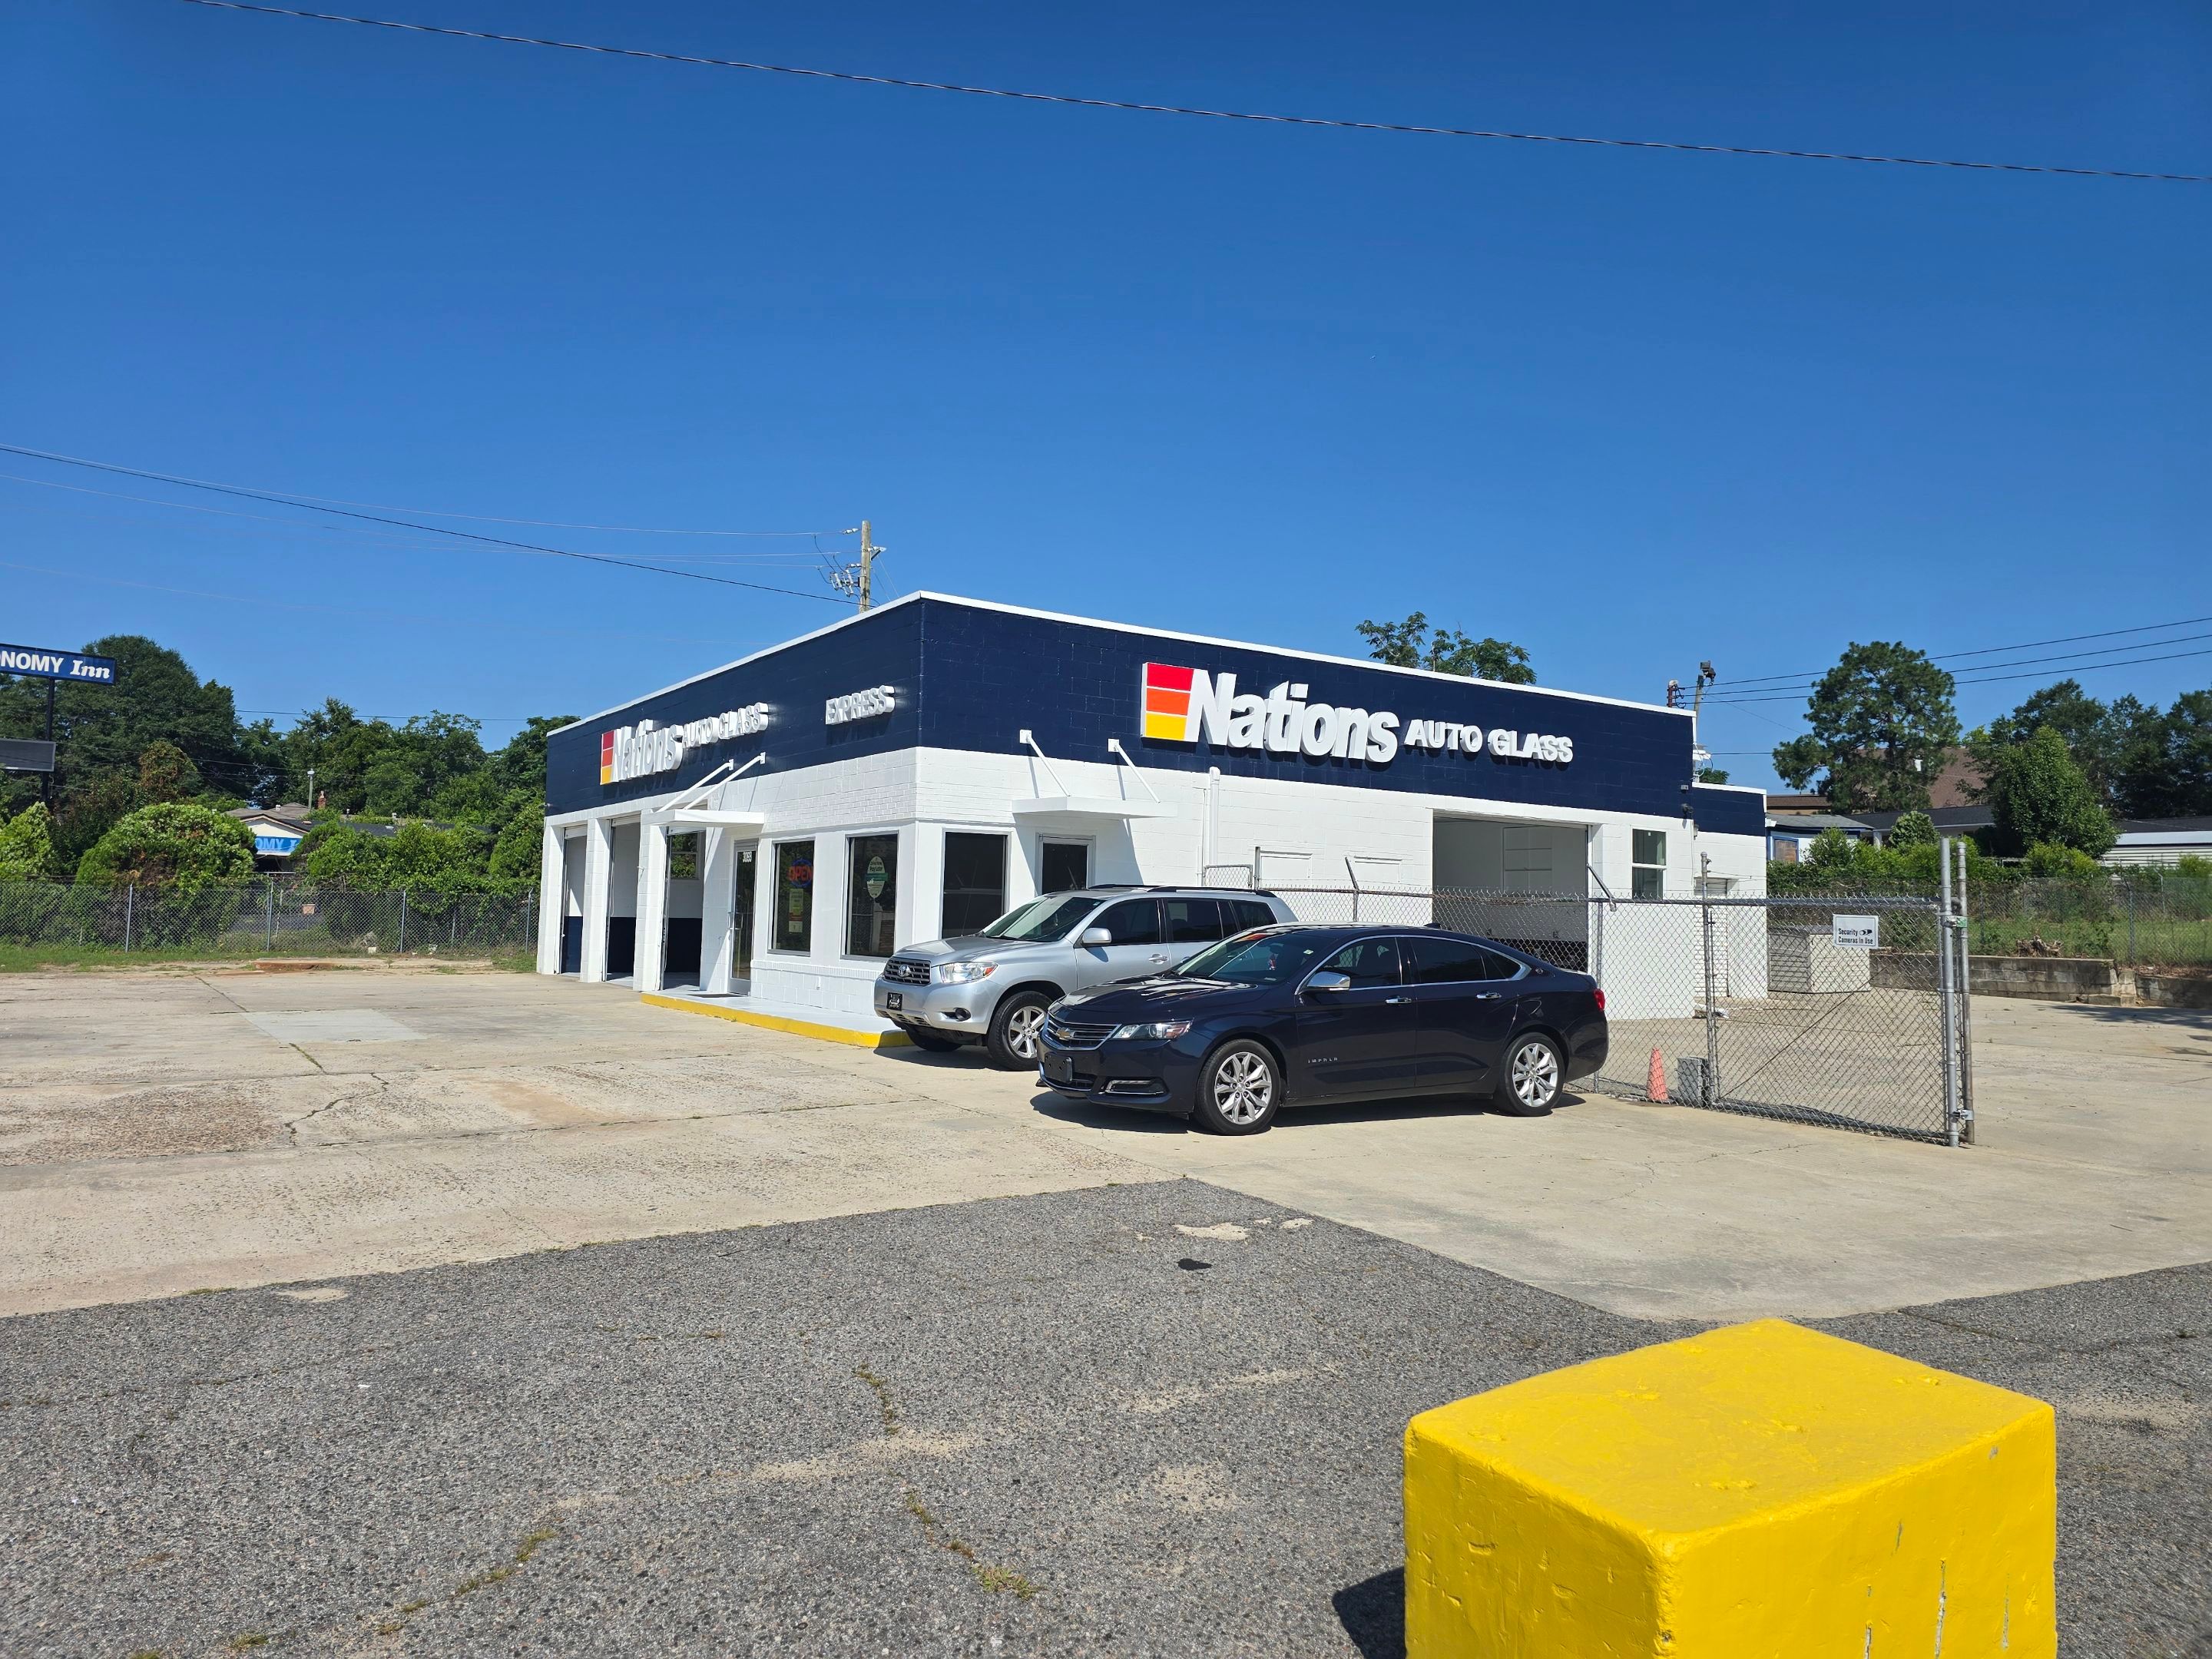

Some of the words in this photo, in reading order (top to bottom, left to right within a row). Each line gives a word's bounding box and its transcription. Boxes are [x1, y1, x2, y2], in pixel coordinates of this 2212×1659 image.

[0, 651, 64, 673] NOMY
[70, 660, 110, 678] Inn
[826, 685, 895, 725] EXPRESS
[1184, 668, 1400, 763] Nations
[1404, 719, 1482, 753] AUTO
[1488, 728, 1574, 763] GLASS
[611, 719, 683, 783] Nations
[682, 717, 719, 748] AUTO
[718, 702, 769, 740] GLASS
[255, 837, 283, 850] OMY
[787, 866, 813, 881] OPEN
[1838, 928, 1858, 936] Security
